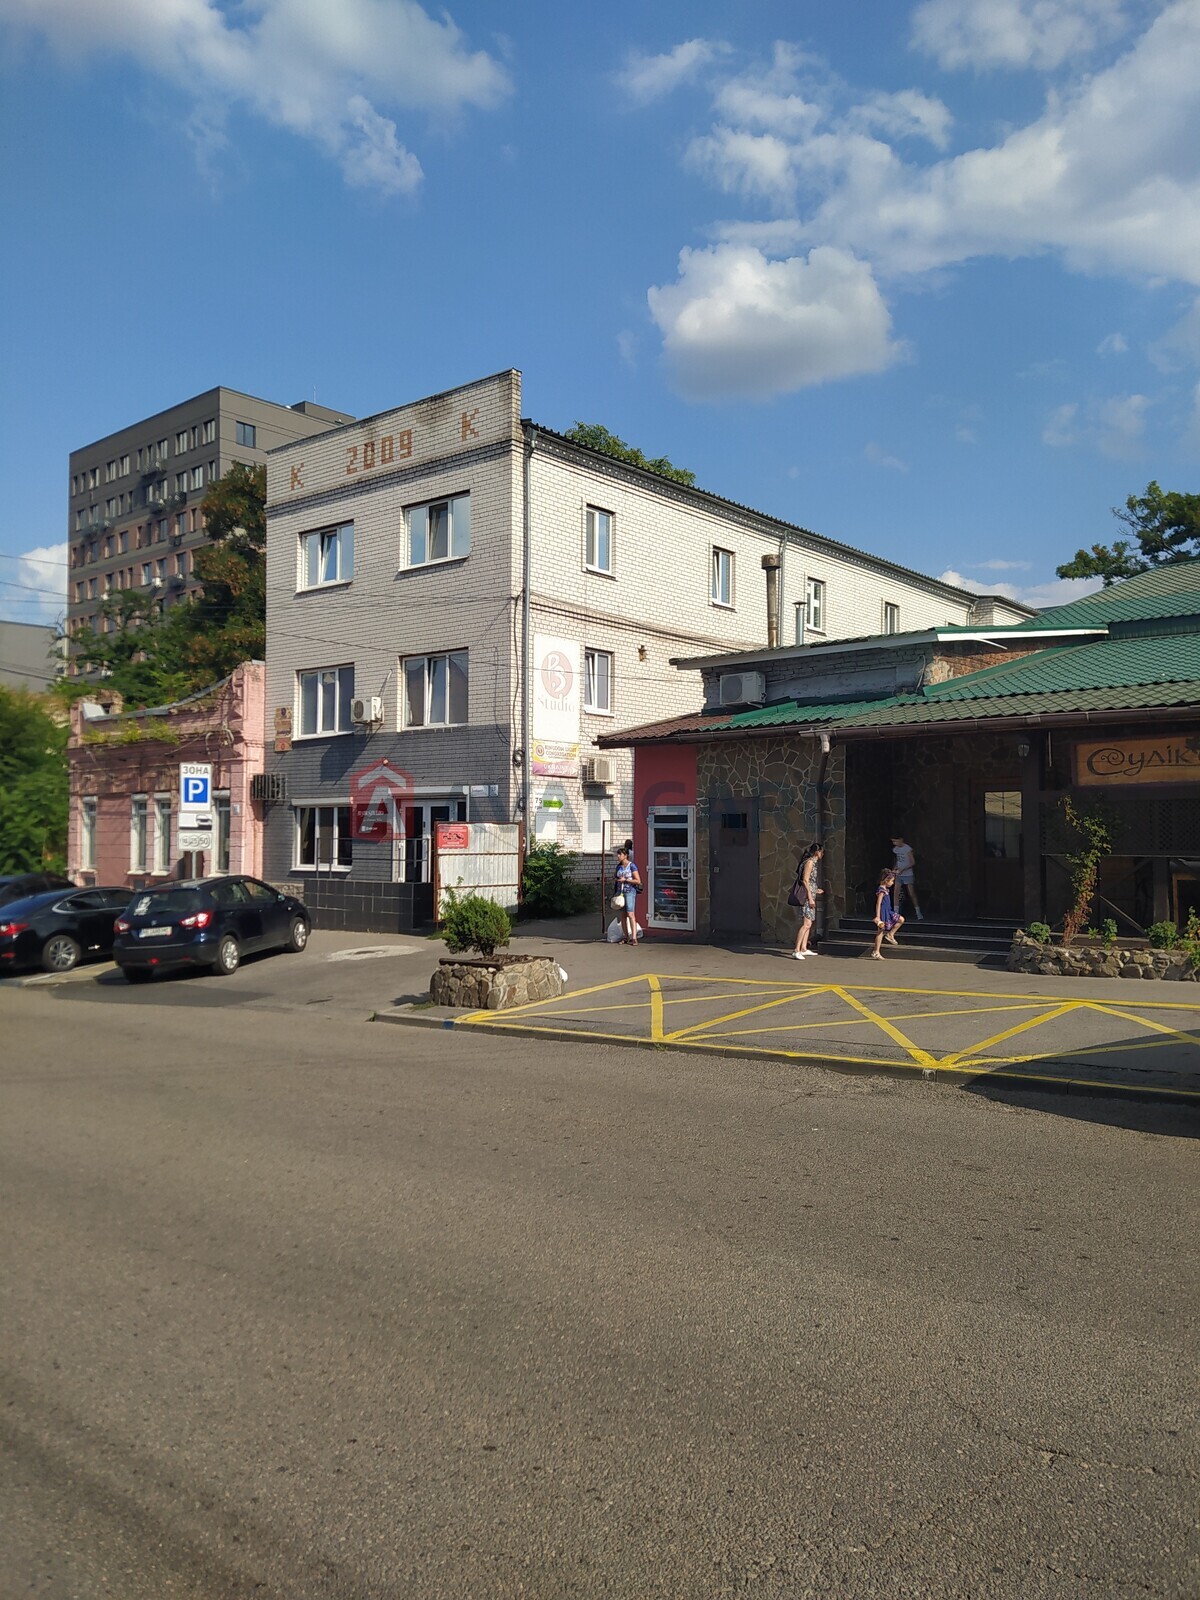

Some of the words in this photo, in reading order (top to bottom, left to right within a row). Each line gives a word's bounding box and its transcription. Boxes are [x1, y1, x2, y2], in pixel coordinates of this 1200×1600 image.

[346, 428, 413, 475] 2009
[537, 693, 576, 713] Studio
[182, 766, 209, 775] ЗОНА
[1086, 745, 1200, 776] Сулік
[188, 779, 204, 801] P
[199, 837, 208, 845] 50
